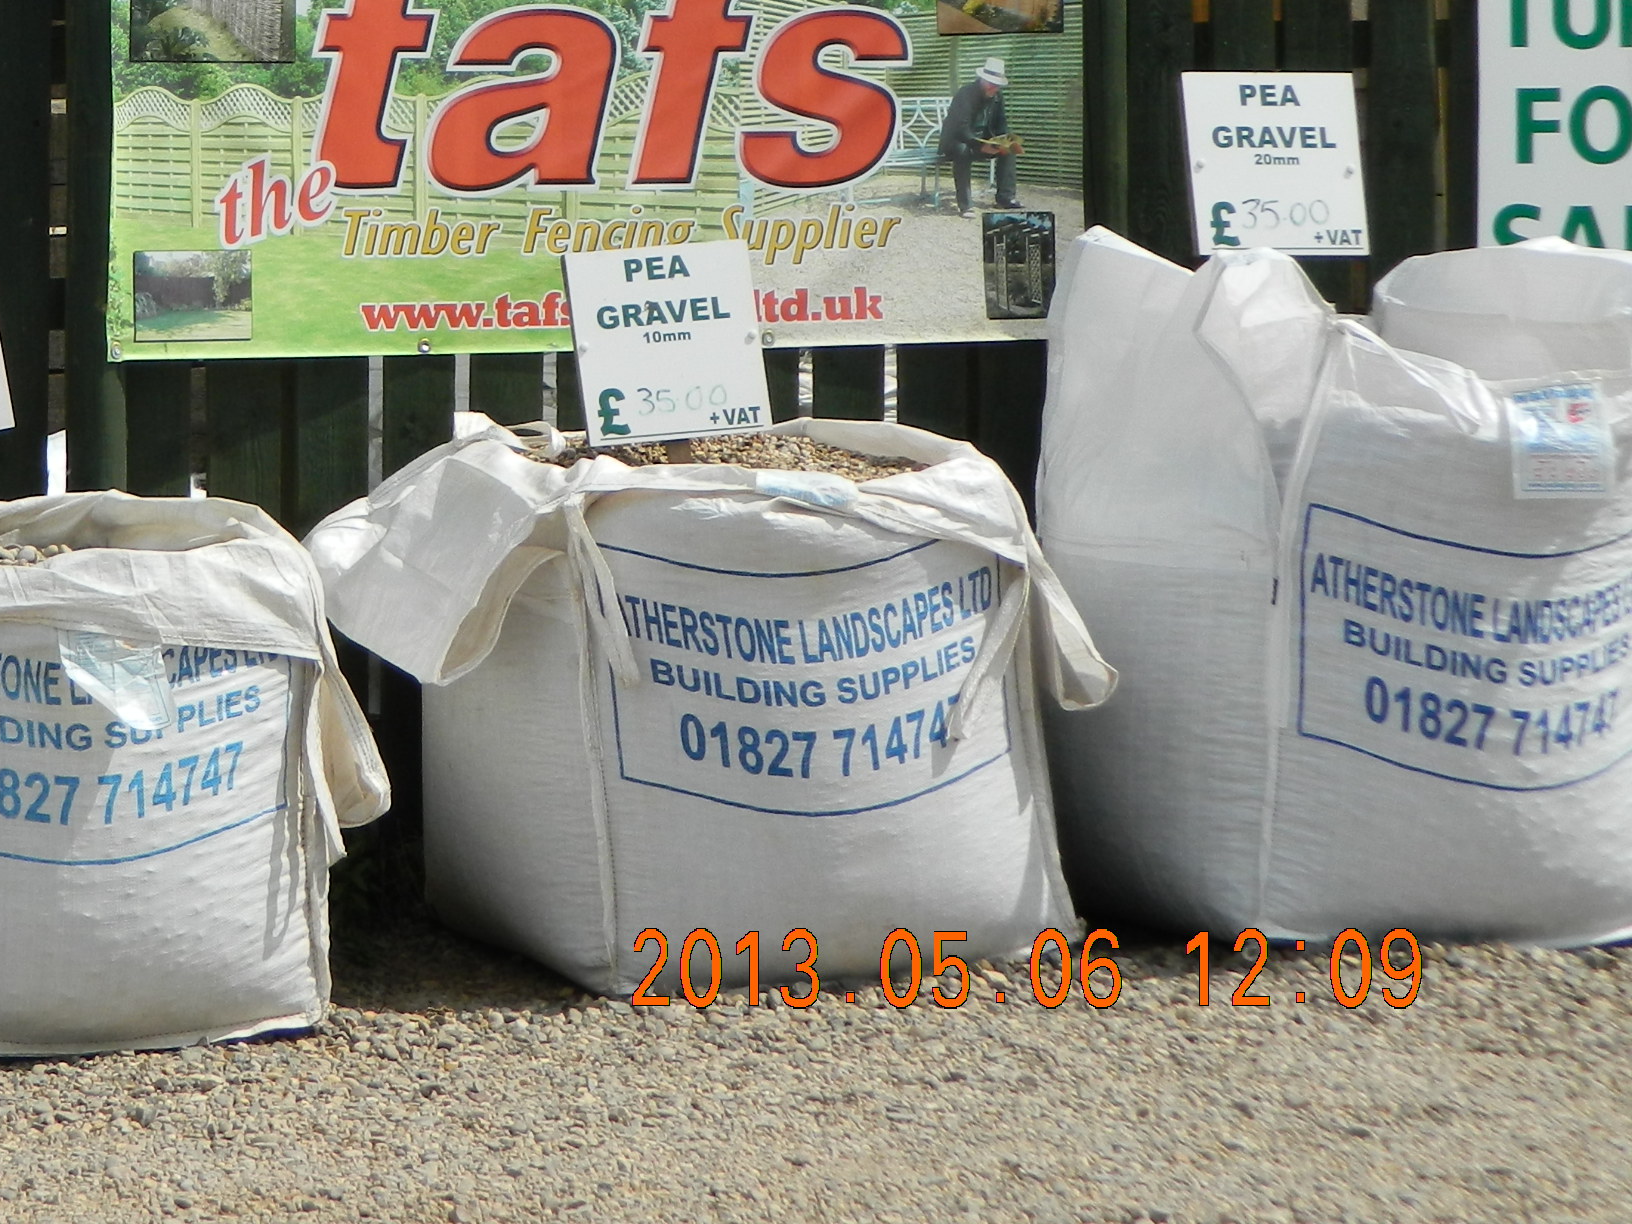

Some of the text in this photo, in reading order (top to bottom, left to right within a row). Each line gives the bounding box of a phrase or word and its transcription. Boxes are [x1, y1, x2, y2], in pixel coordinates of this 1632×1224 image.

[1239, 84, 1301, 106] PEA
[1212, 126, 1336, 148] GRAVEL
[1254, 154, 1300, 165] 20mm
[218, 155, 338, 248] the
[342, 204, 902, 265] Timber Fencing Supplier
[623, 255, 690, 282] PEA
[597, 296, 731, 329] GRAVEL
[643, 331, 691, 344] 10mm
[798, 581, 954, 664] LANDSCAPES
[958, 566, 992, 620] LTD
[1310, 552, 1485, 639] ATHERSTONE
[650, 635, 976, 708] BUILDING SUPPLIES
[1343, 618, 1630, 687] BUILDING SUPPLIES
[104, 684, 261, 749] SUPLIES
[680, 712, 818, 779] 01827
[1367, 676, 1620, 756] 01827 714747
[98, 741, 244, 825] 714747
